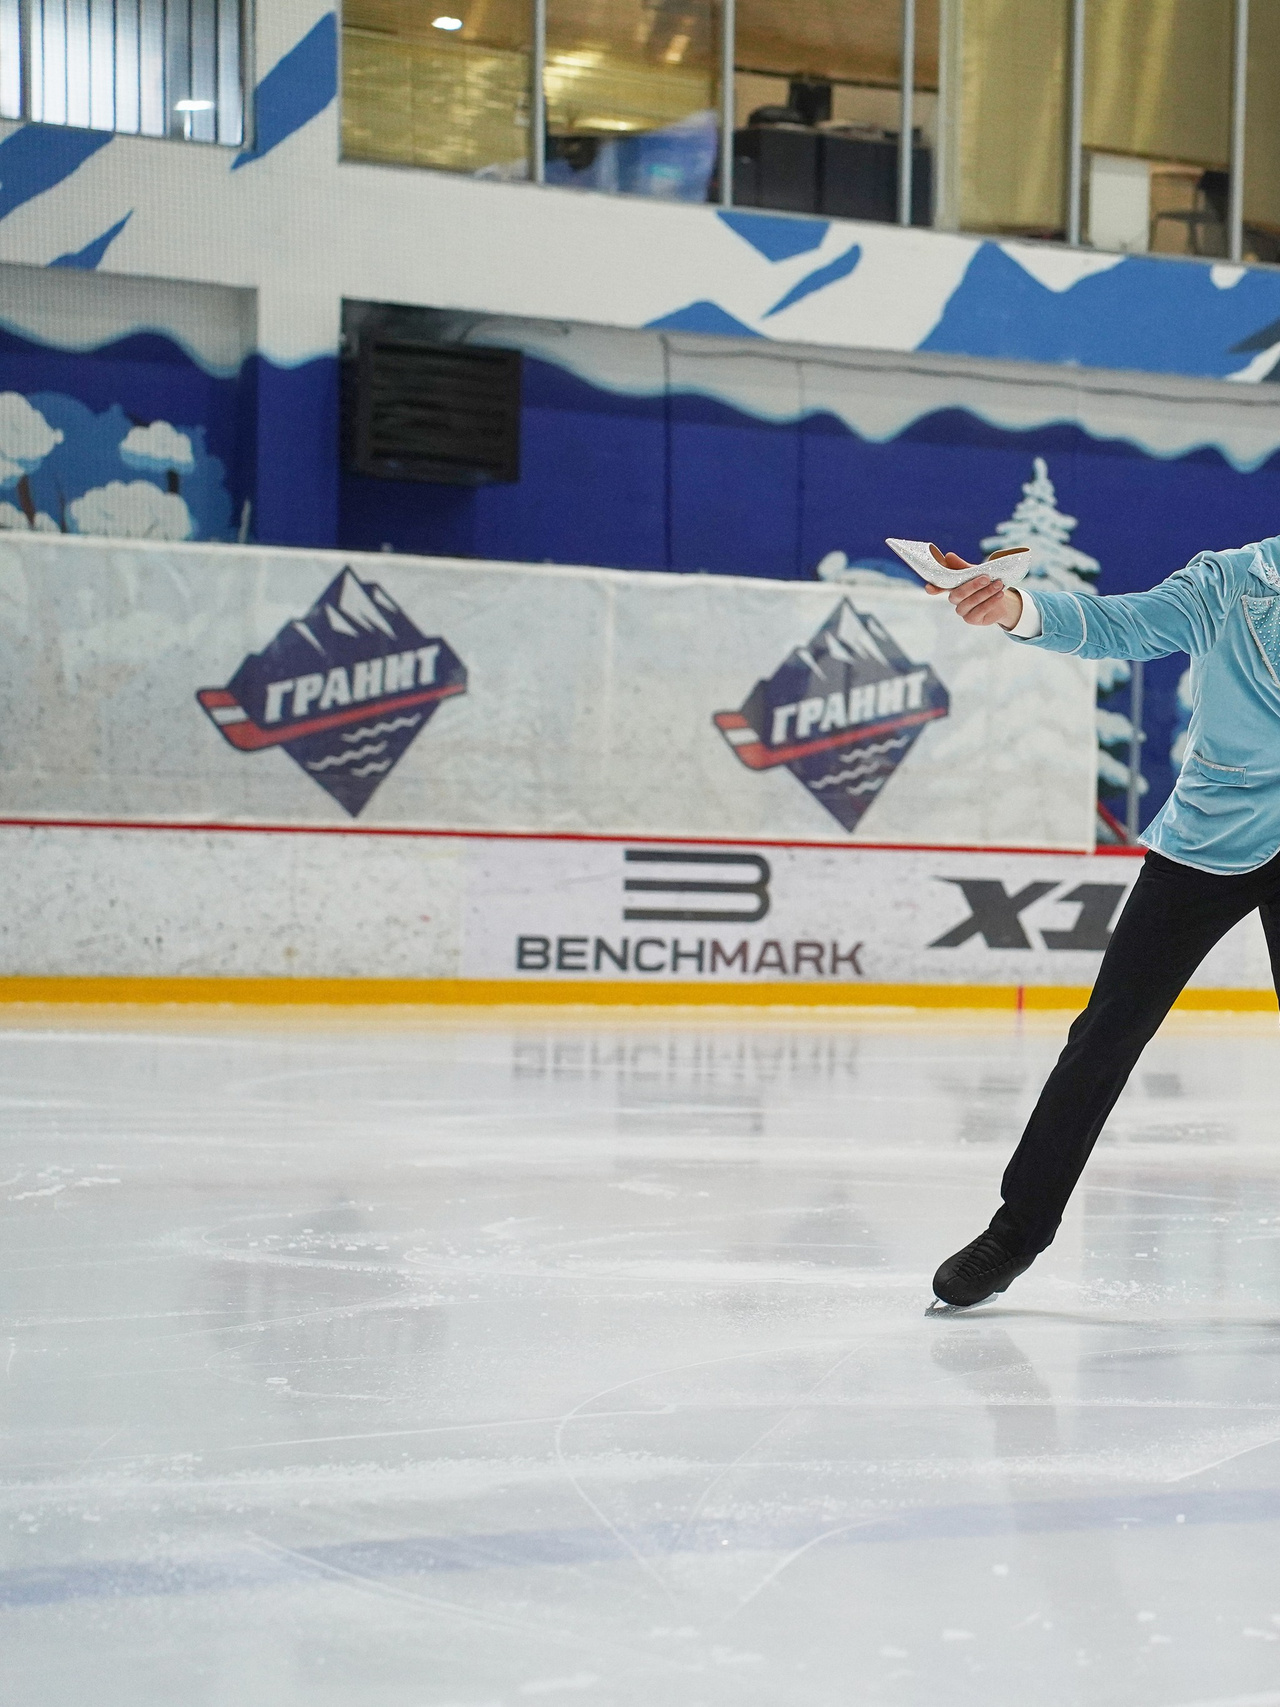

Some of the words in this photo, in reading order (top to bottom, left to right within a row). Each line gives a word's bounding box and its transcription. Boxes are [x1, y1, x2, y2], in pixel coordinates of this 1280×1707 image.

[264, 643, 440, 724] ГРАНИТ
[770, 669, 928, 745] ГРАНИТ
[927, 876, 1128, 951] X1
[516, 935, 864, 976] BENCHMARK
